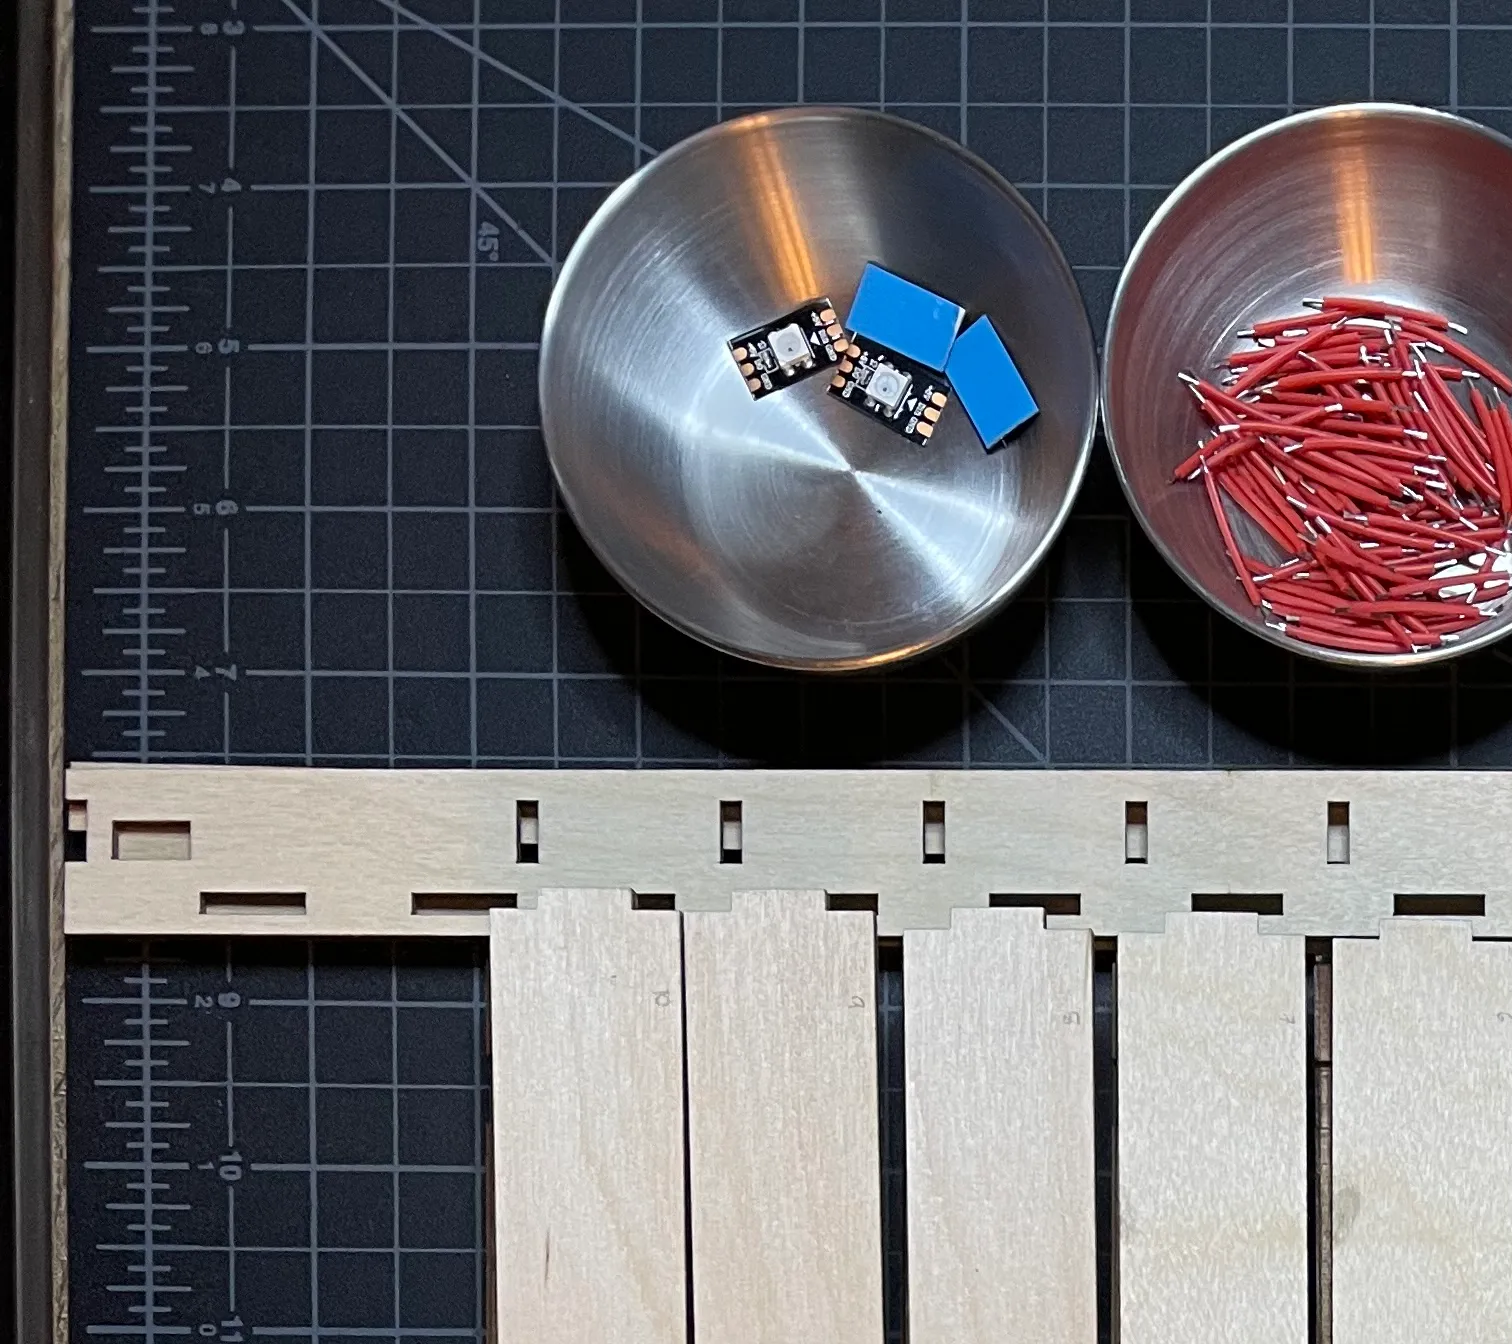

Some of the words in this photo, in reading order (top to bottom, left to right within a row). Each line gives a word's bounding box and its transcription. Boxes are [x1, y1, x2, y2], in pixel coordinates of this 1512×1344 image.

[223, 20, 245, 35] 3
[221, 178, 241, 192] 4
[218, 339, 239, 354] 5
[216, 500, 238, 515] 6
[215, 664, 236, 681] 7
[218, 992, 240, 1007] 9
[220, 1151, 242, 1180] 10
[220, 1316, 243, 1342] 11
